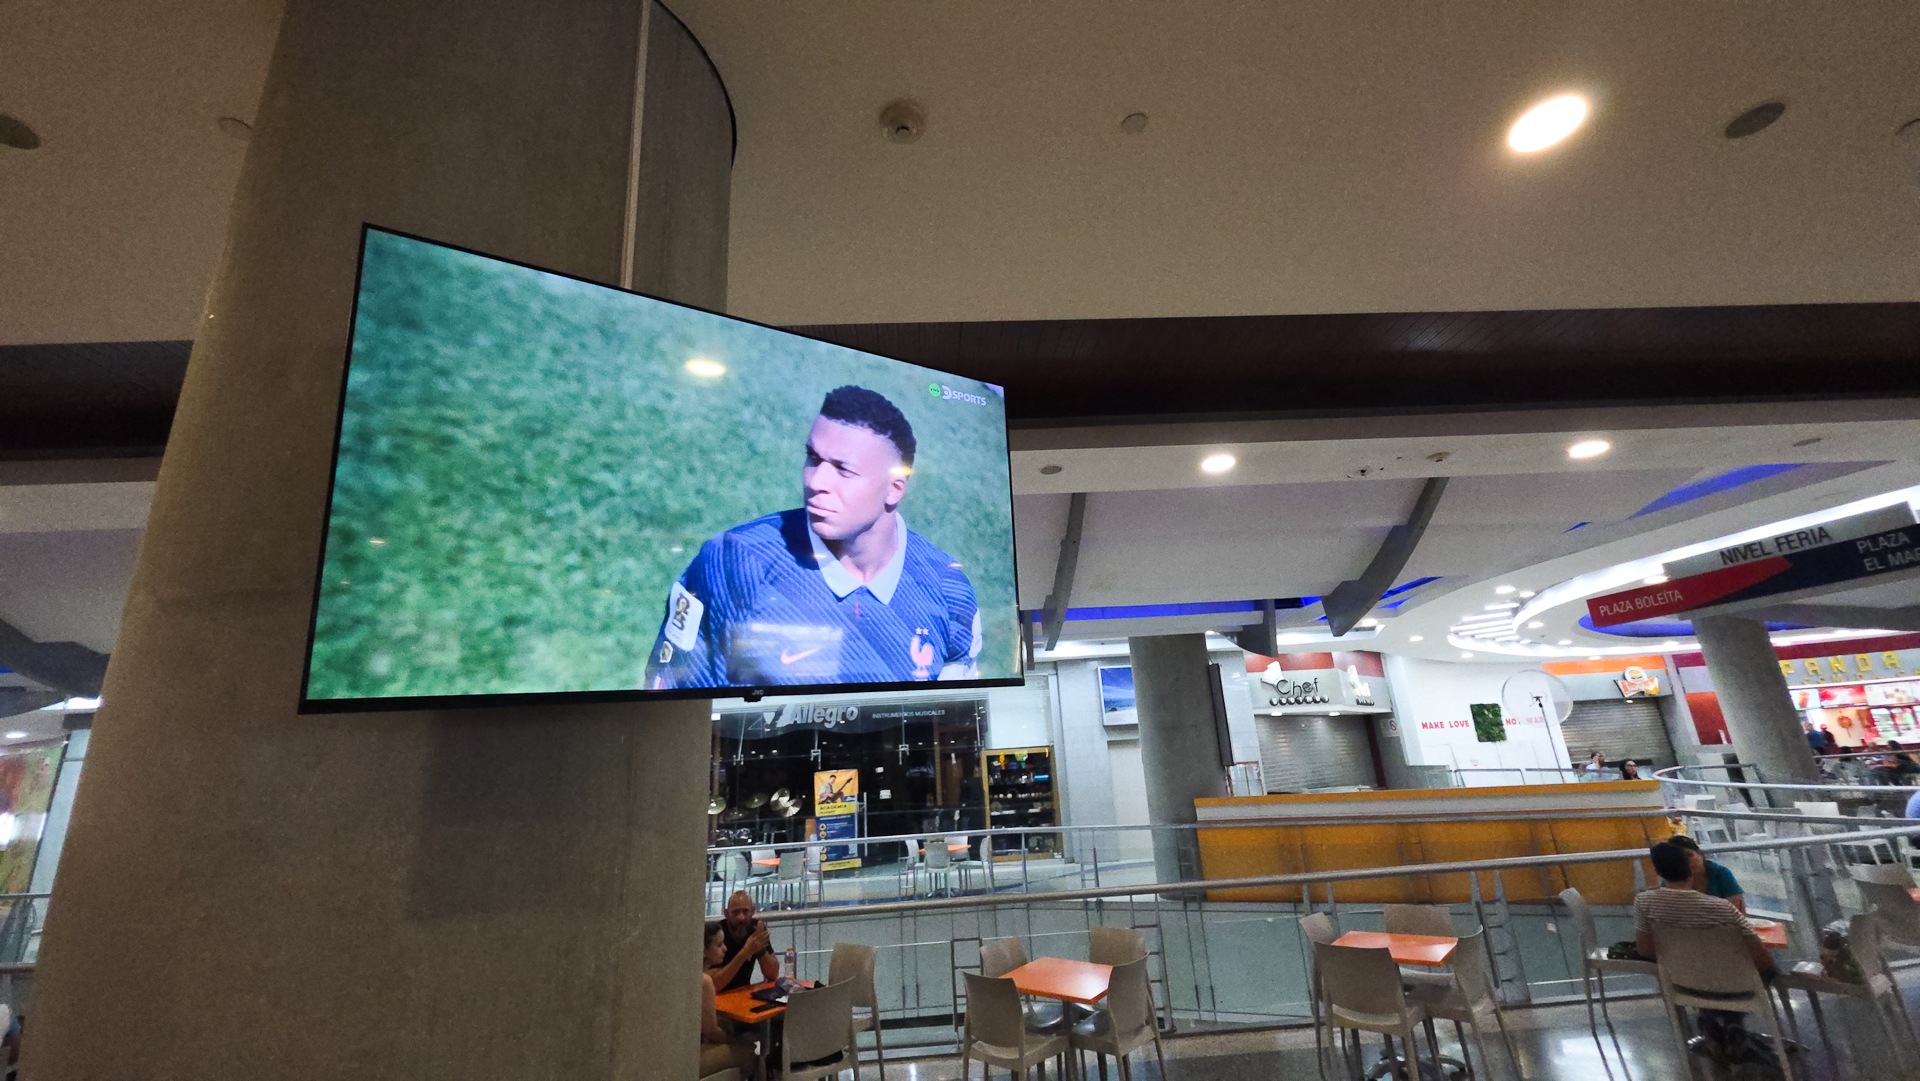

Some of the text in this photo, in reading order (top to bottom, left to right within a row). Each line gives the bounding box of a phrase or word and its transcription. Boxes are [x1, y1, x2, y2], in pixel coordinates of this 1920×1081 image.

[1720, 526, 1833, 566] NIVEL FERIA
[1856, 532, 1912, 554] PLAZA
[1863, 556, 1886, 571] EL
[1599, 600, 1634, 616] PLAZA
[1778, 651, 1900, 678] PANDA
[1277, 677, 1319, 696] Chef
[782, 702, 860, 729] Allegro
[915, 709, 946, 717] MUSICALES
[1421, 721, 1445, 730] MAKE
[1449, 720, 1470, 728] LOVE
[1525, 716, 1546, 724] WAR
